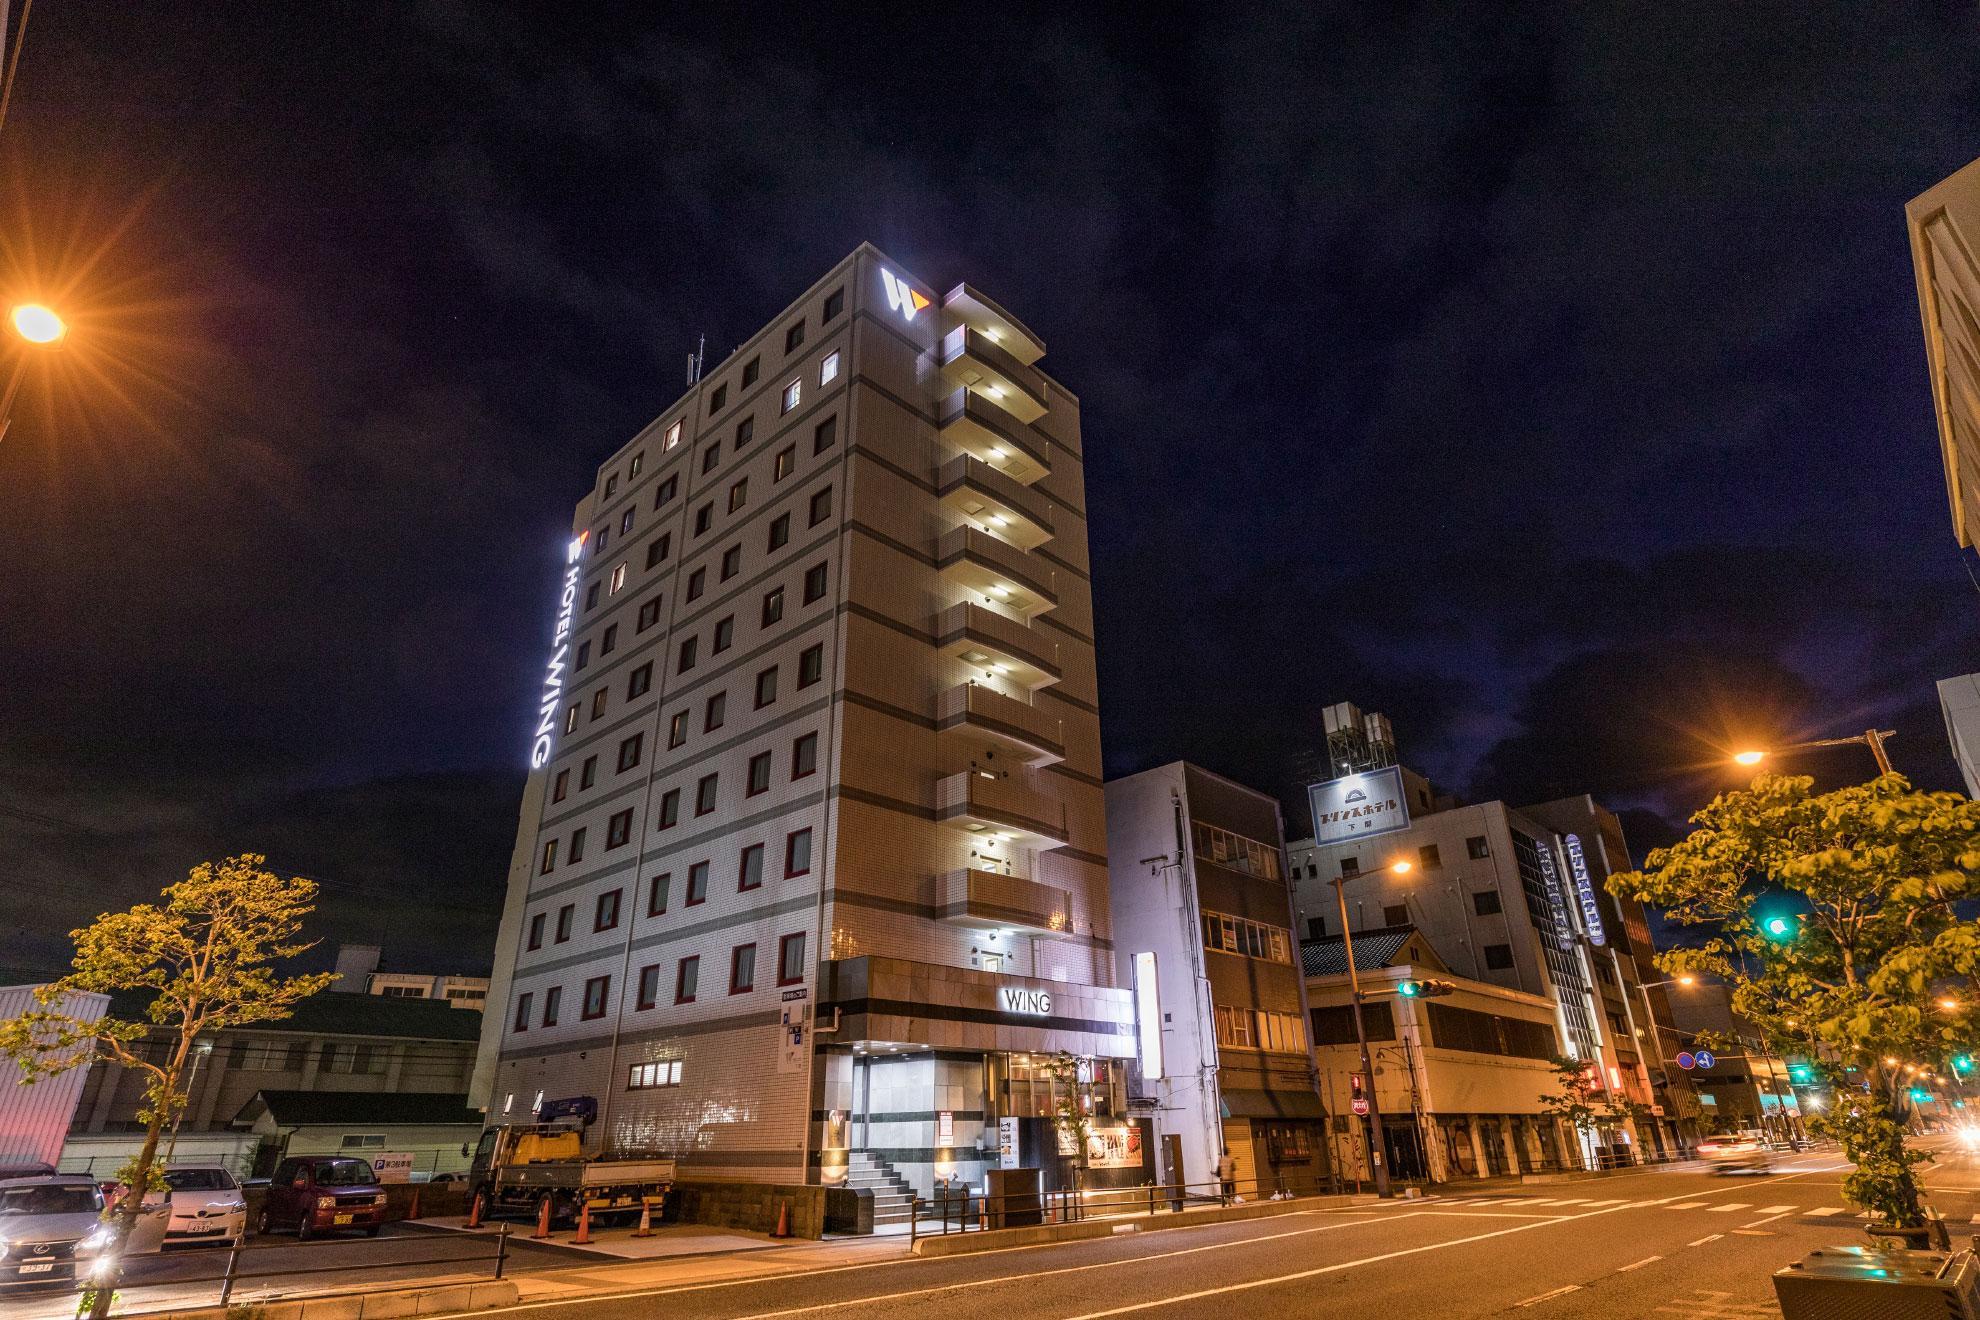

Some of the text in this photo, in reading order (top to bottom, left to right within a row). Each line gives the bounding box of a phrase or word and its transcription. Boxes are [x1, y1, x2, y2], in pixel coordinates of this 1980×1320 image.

[531, 565, 579, 769] HOTEL WING
[1005, 989, 1051, 1013] WING
